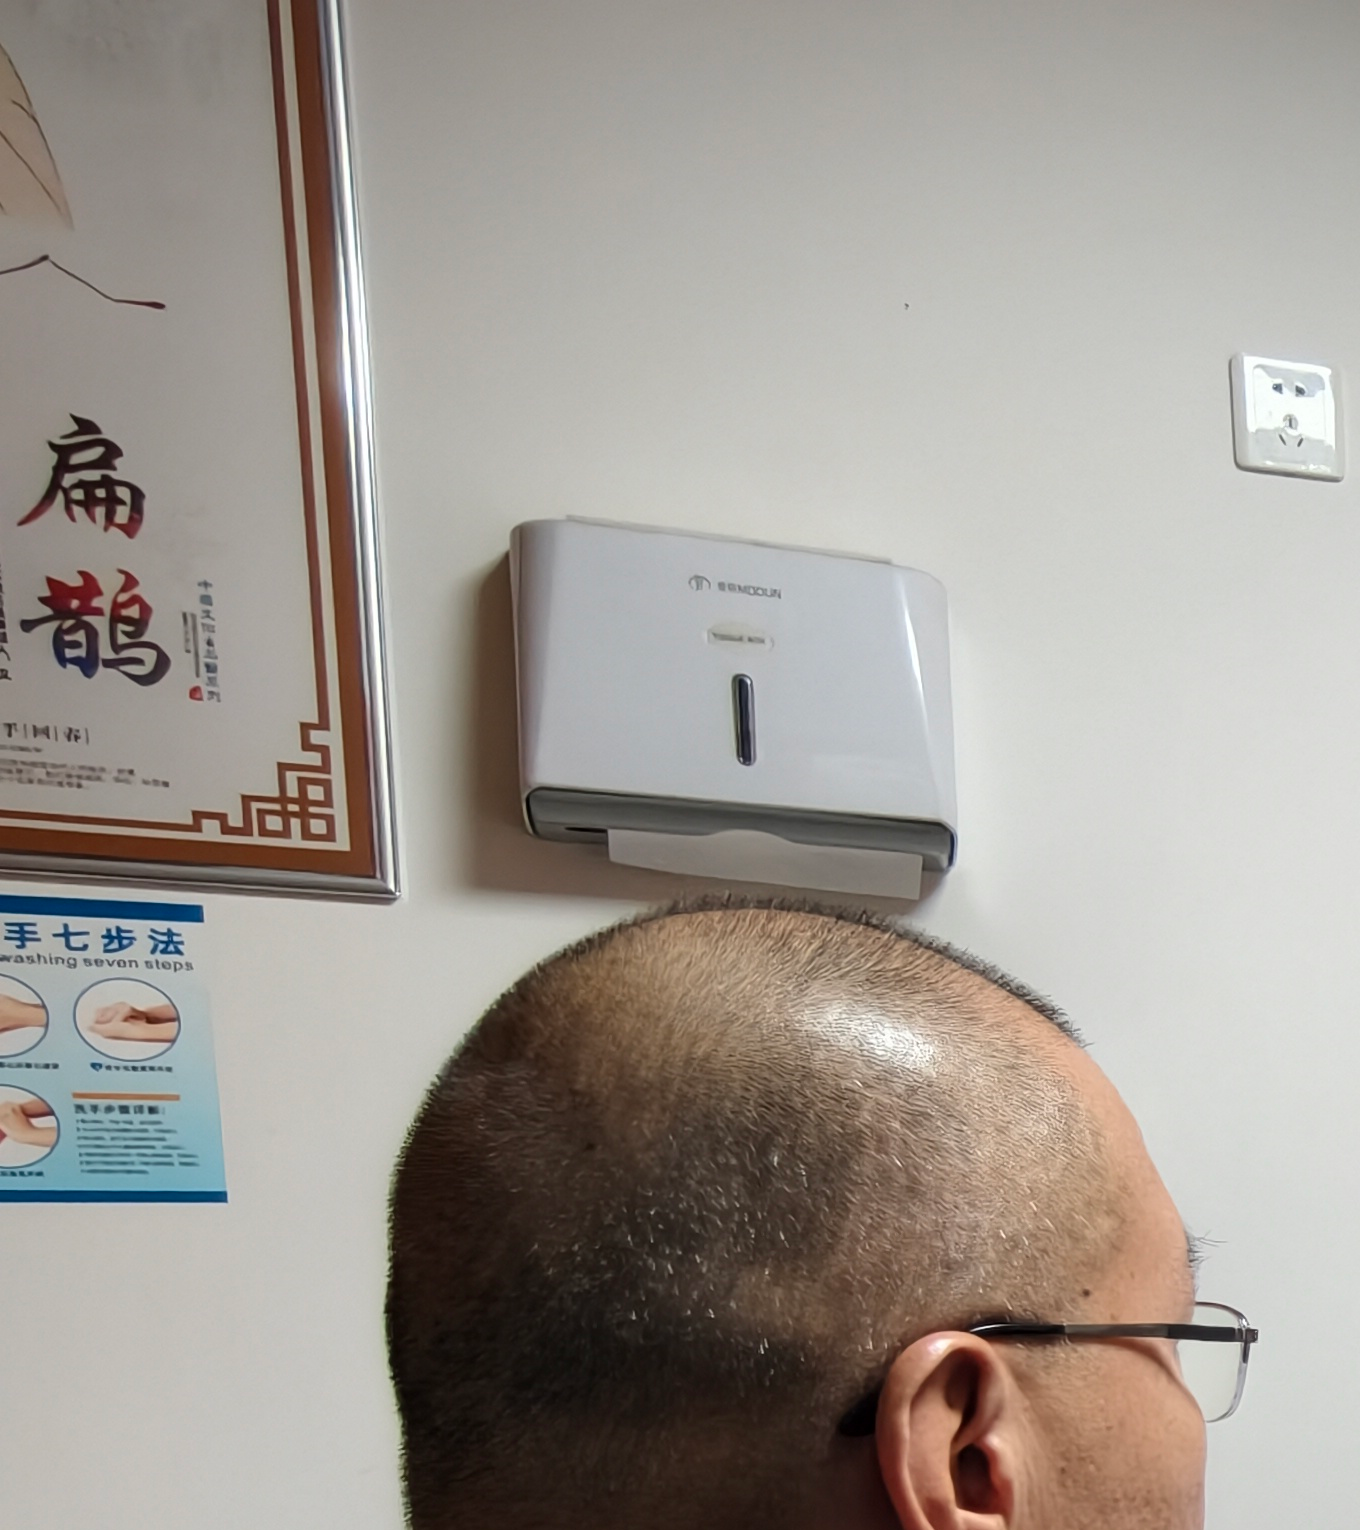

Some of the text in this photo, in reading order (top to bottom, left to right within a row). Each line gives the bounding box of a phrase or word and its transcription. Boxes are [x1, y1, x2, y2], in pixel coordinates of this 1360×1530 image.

[17, 412, 172, 687] 扁鹊
[4, 922, 185, 956] 手七步法
[83, 957, 139, 969] seven
[144, 958, 195, 973] steps
